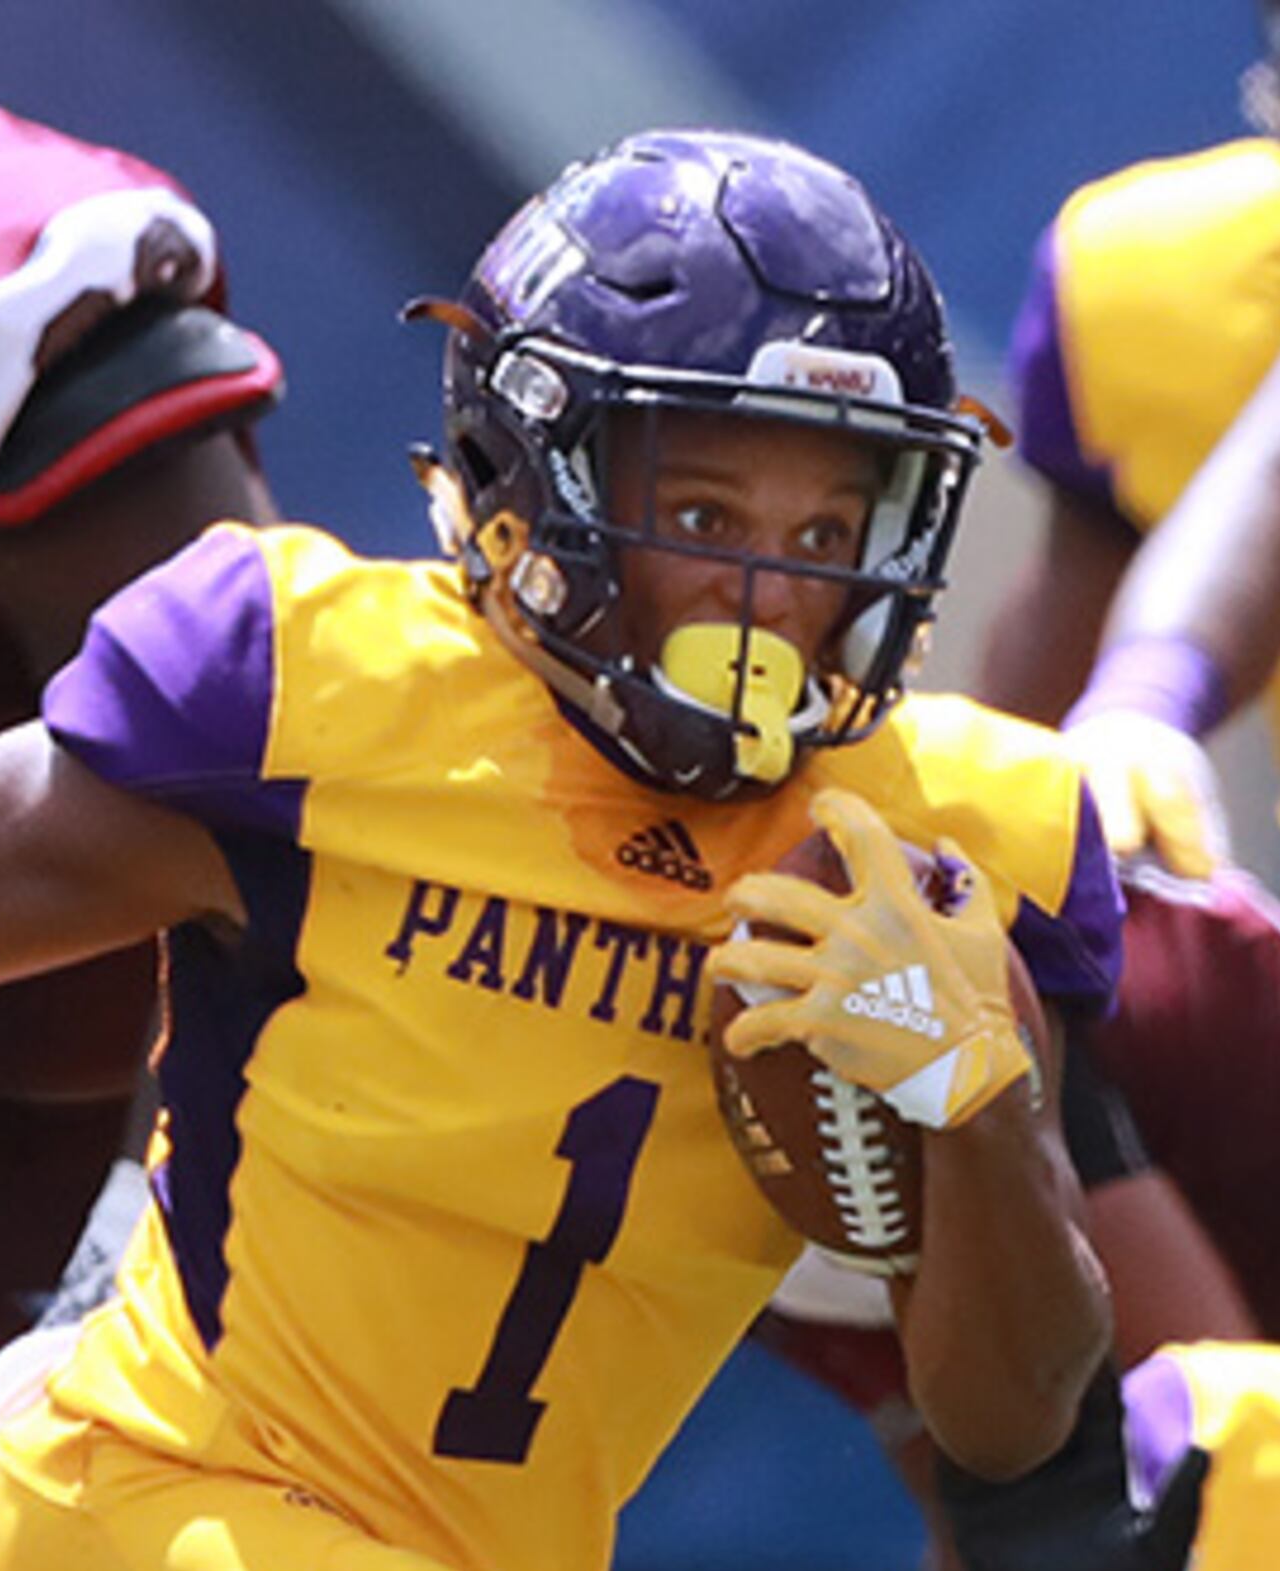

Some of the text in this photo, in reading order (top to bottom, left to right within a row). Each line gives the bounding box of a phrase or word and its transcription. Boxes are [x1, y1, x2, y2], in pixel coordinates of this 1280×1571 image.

[616, 841, 713, 893] adidas
[384, 878, 712, 1044] PANTH
[842, 991, 946, 1040] adidas
[432, 1073, 662, 1465] 1
